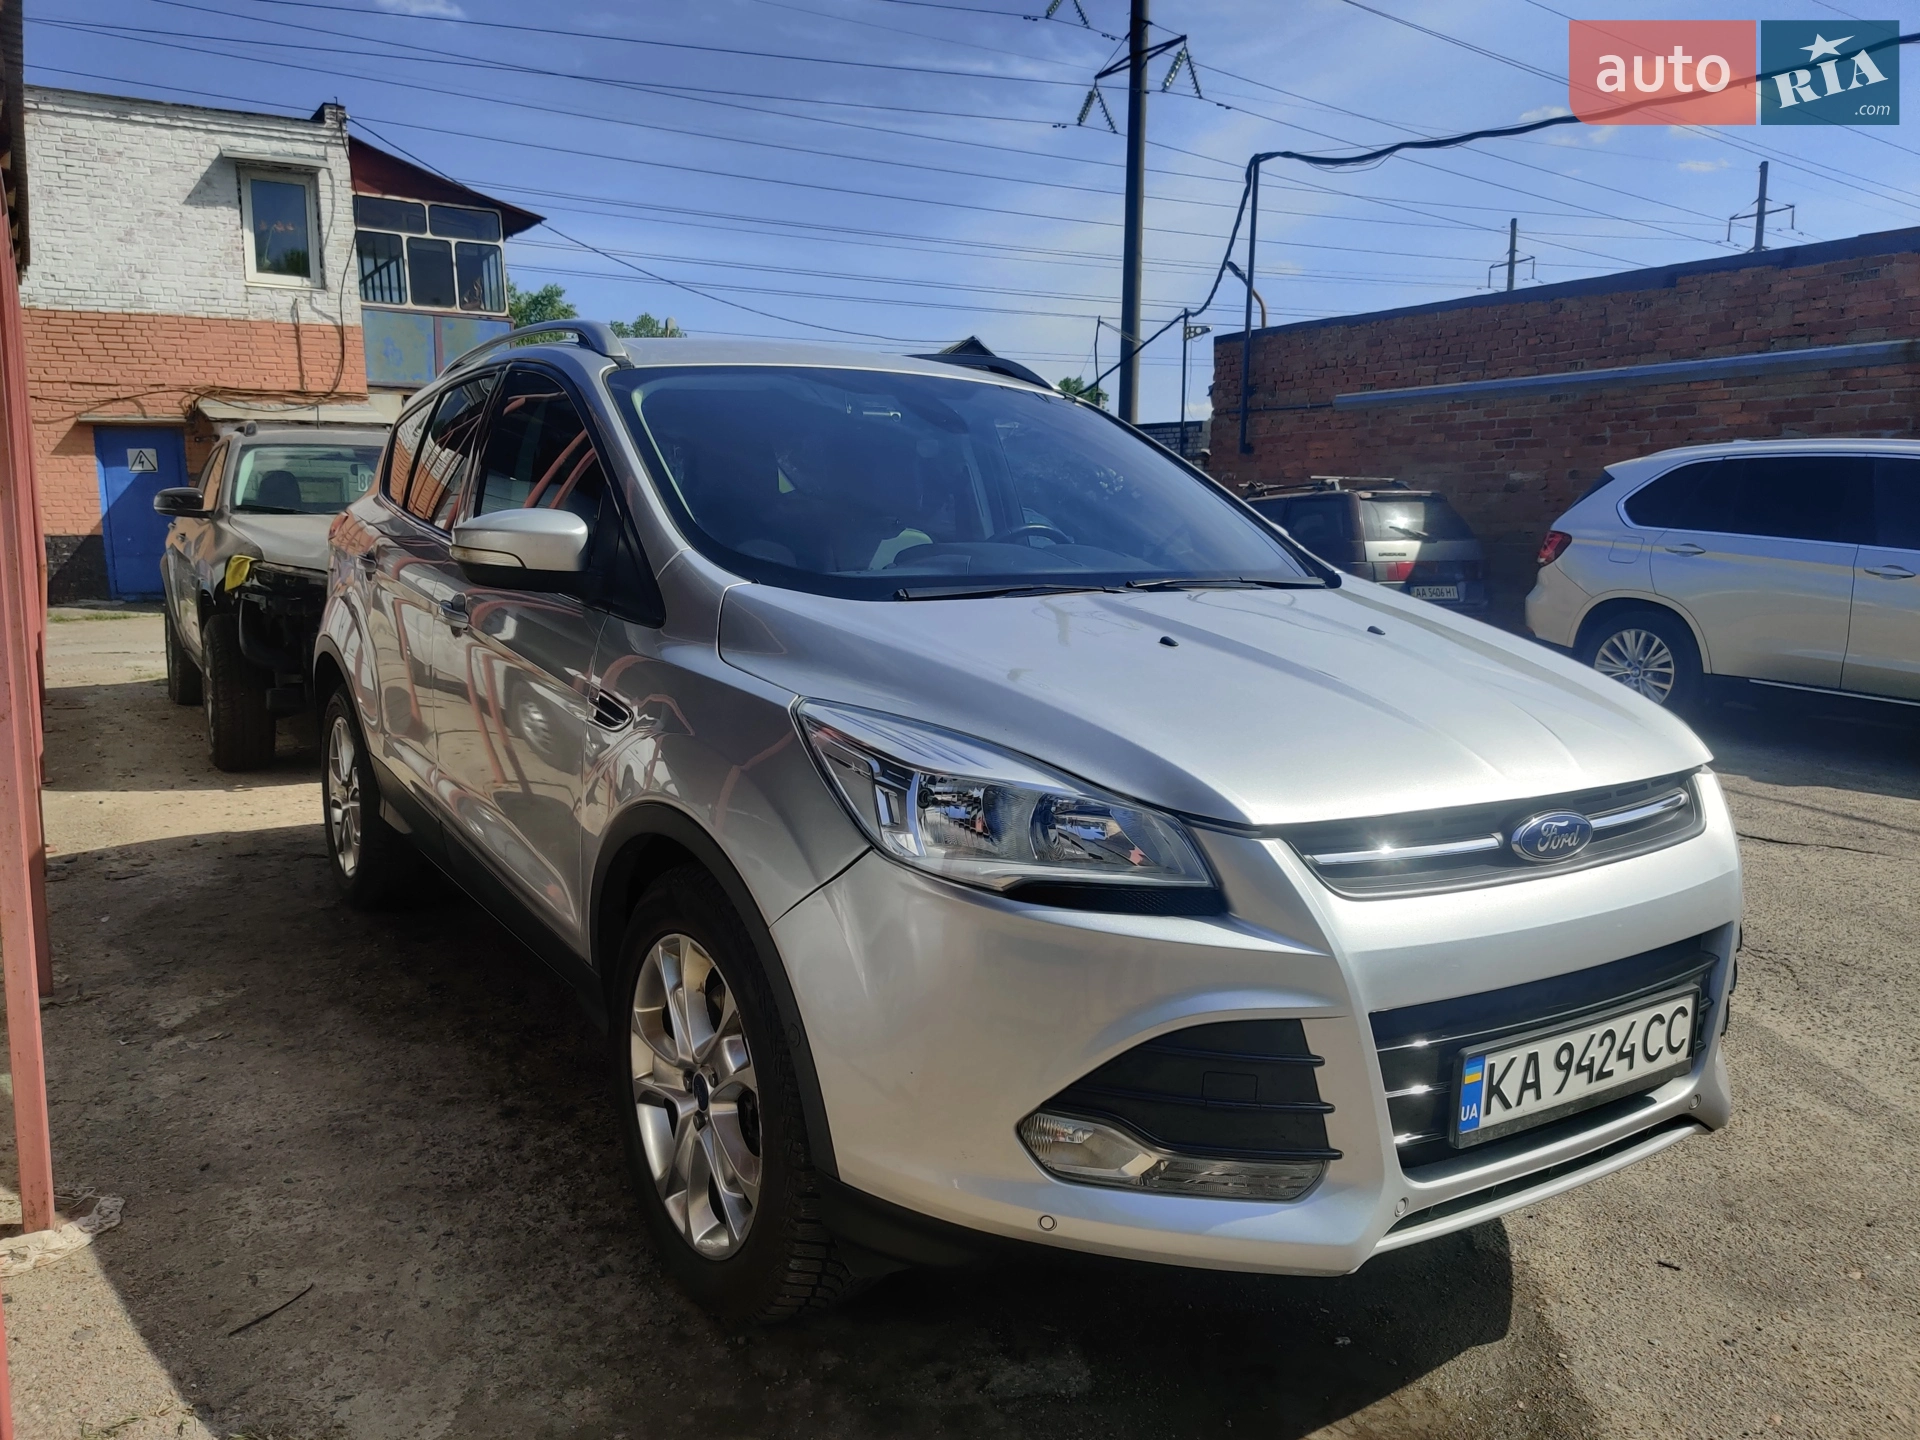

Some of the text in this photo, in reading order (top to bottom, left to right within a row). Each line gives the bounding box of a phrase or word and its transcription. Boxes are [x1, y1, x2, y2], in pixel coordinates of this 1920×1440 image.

[1416, 588, 1427, 598] AA
[1537, 820, 1580, 852] Ford
[1484, 1005, 1689, 1116] KA 9424 CC
[1460, 1104, 1479, 1121] UA
